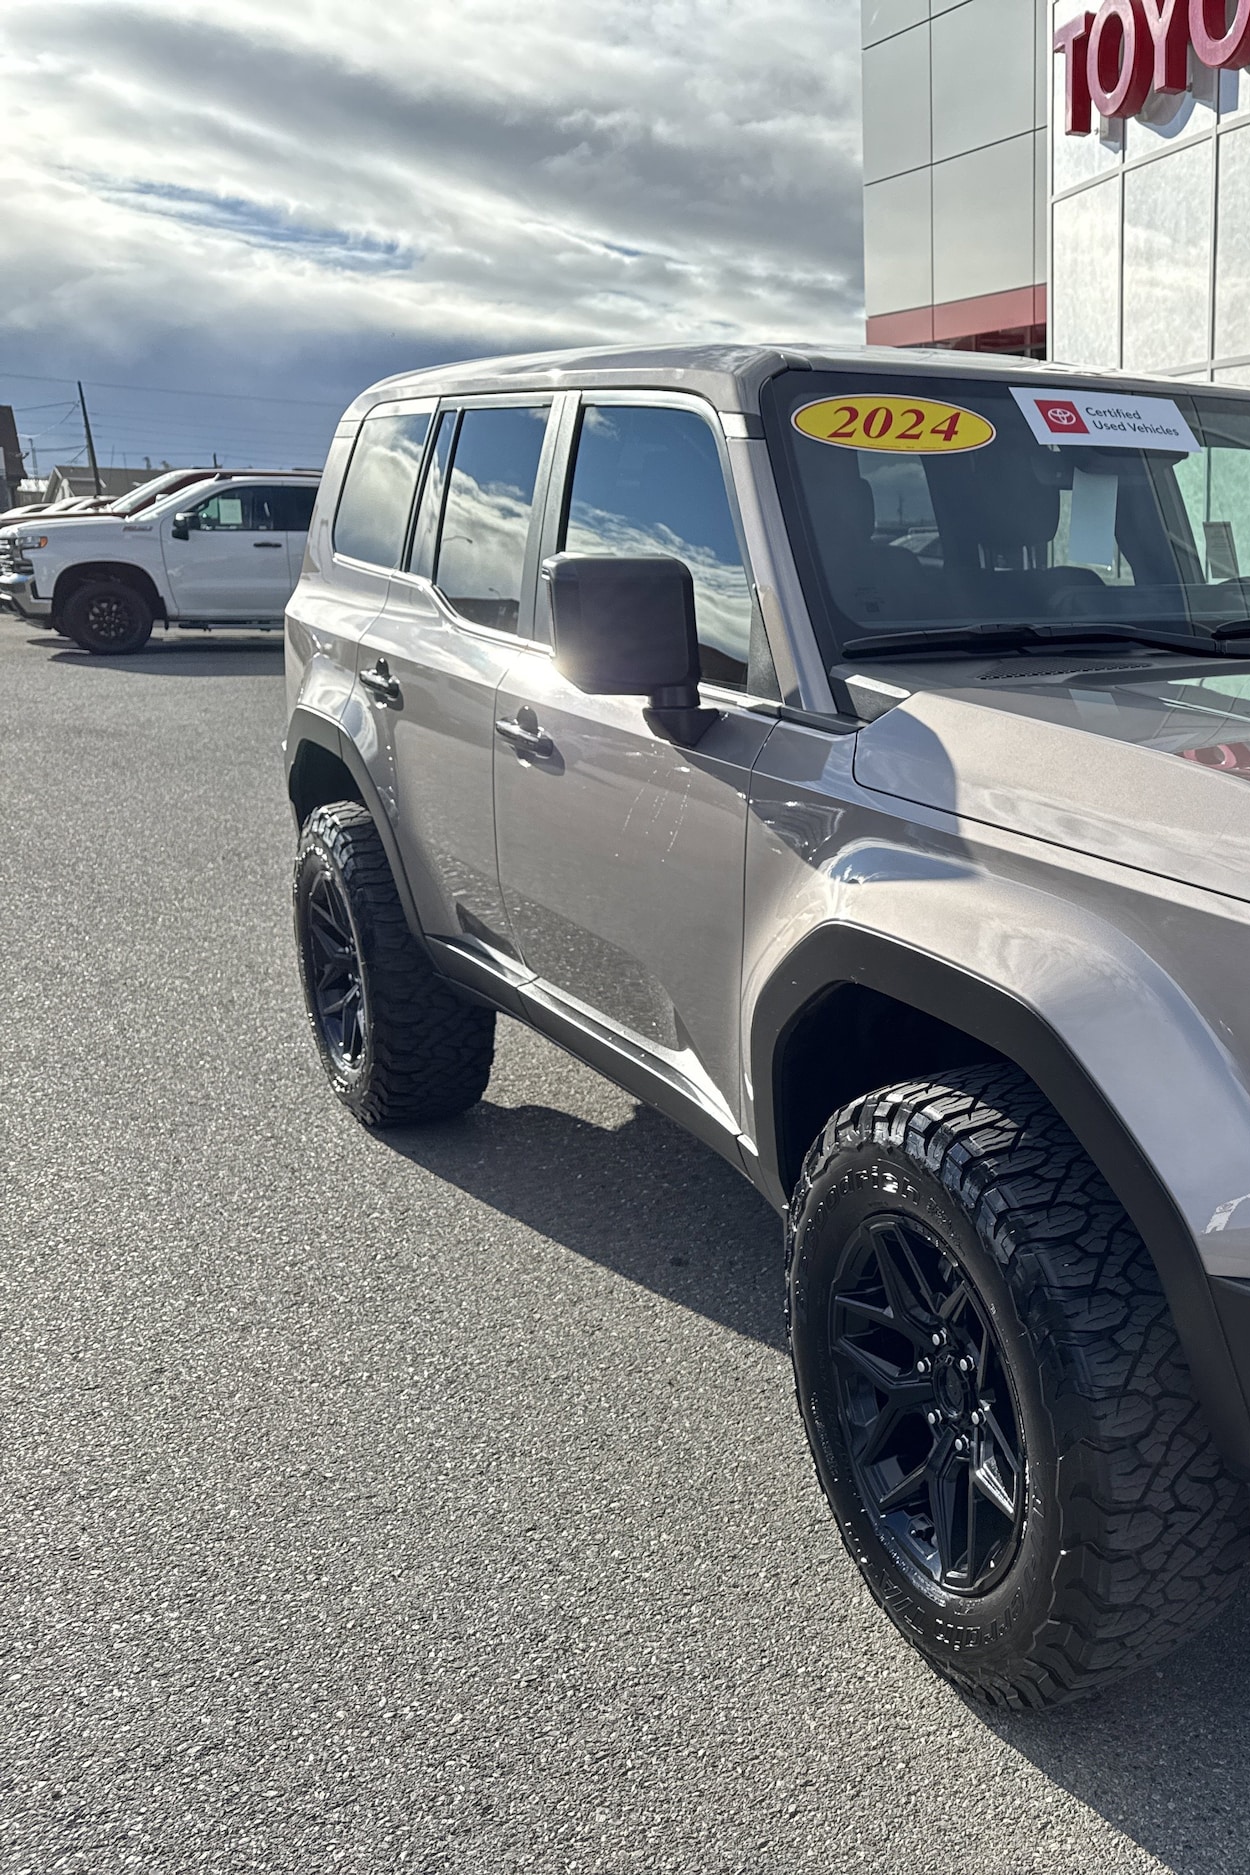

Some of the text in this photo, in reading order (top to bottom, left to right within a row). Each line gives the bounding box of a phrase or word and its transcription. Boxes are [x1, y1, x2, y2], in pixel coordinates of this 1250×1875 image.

[1085, 405, 1142, 422] Certified
[827, 405, 962, 442] 2024
[1092, 420, 1180, 437] Used Vehicles
